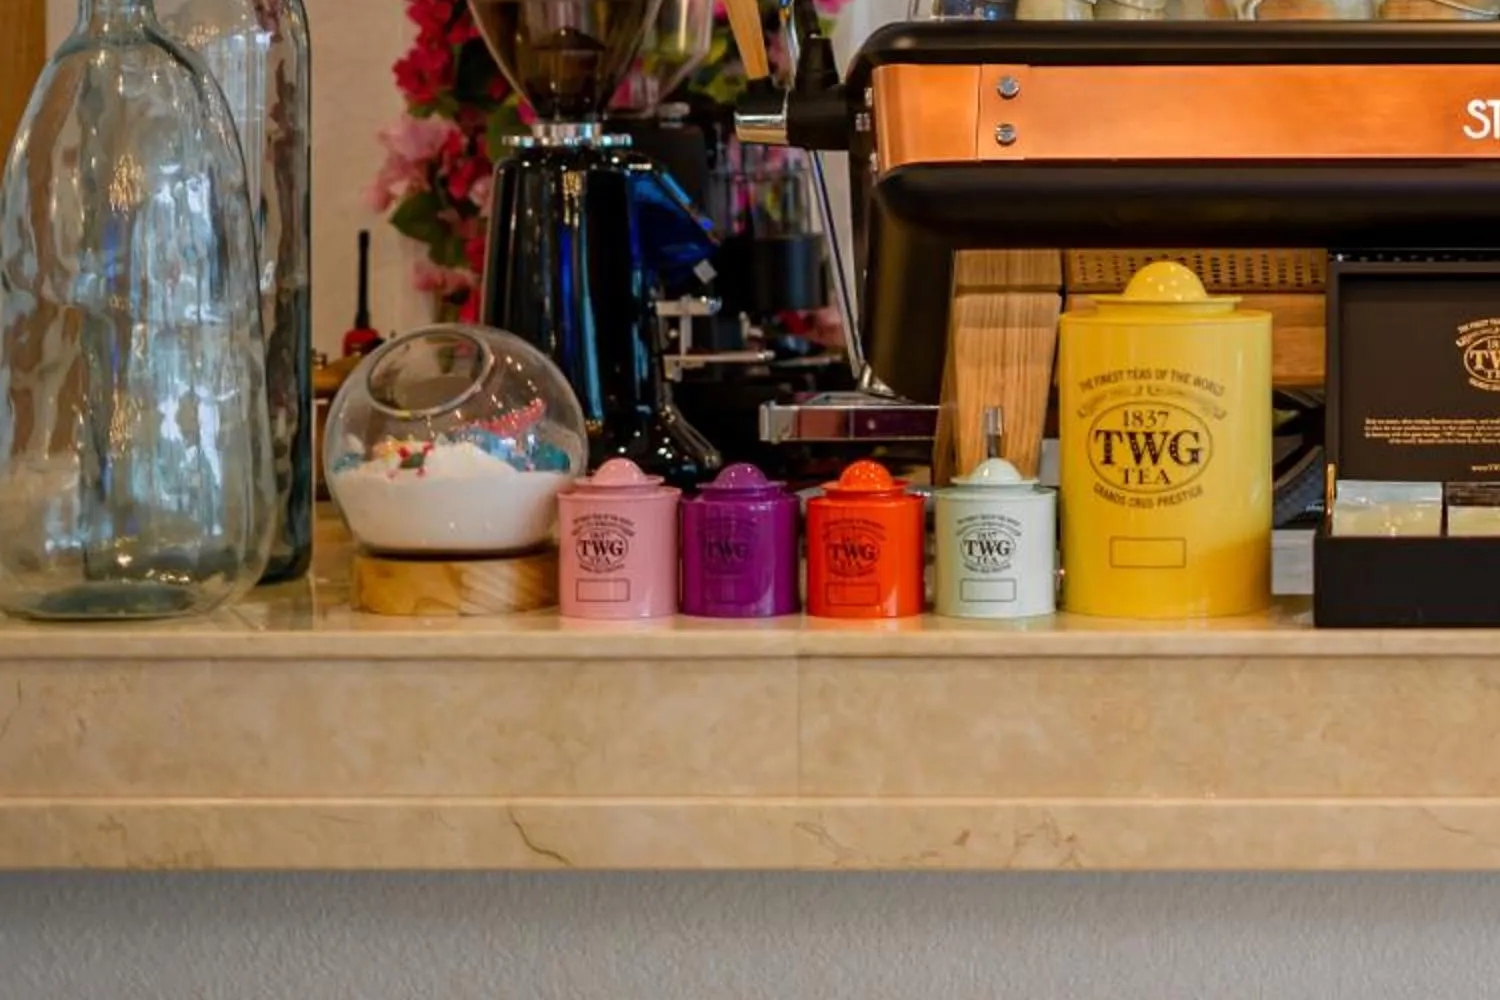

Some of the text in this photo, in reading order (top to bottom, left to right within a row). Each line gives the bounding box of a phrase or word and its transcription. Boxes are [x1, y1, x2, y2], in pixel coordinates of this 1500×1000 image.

[1123, 409, 1169, 428] 1837
[1095, 429, 1204, 467] TWG
[1118, 467, 1172, 485] TEA
[579, 539, 624, 557] TWG
[827, 543, 876, 561] TWG
[963, 539, 1011, 556] TWG
